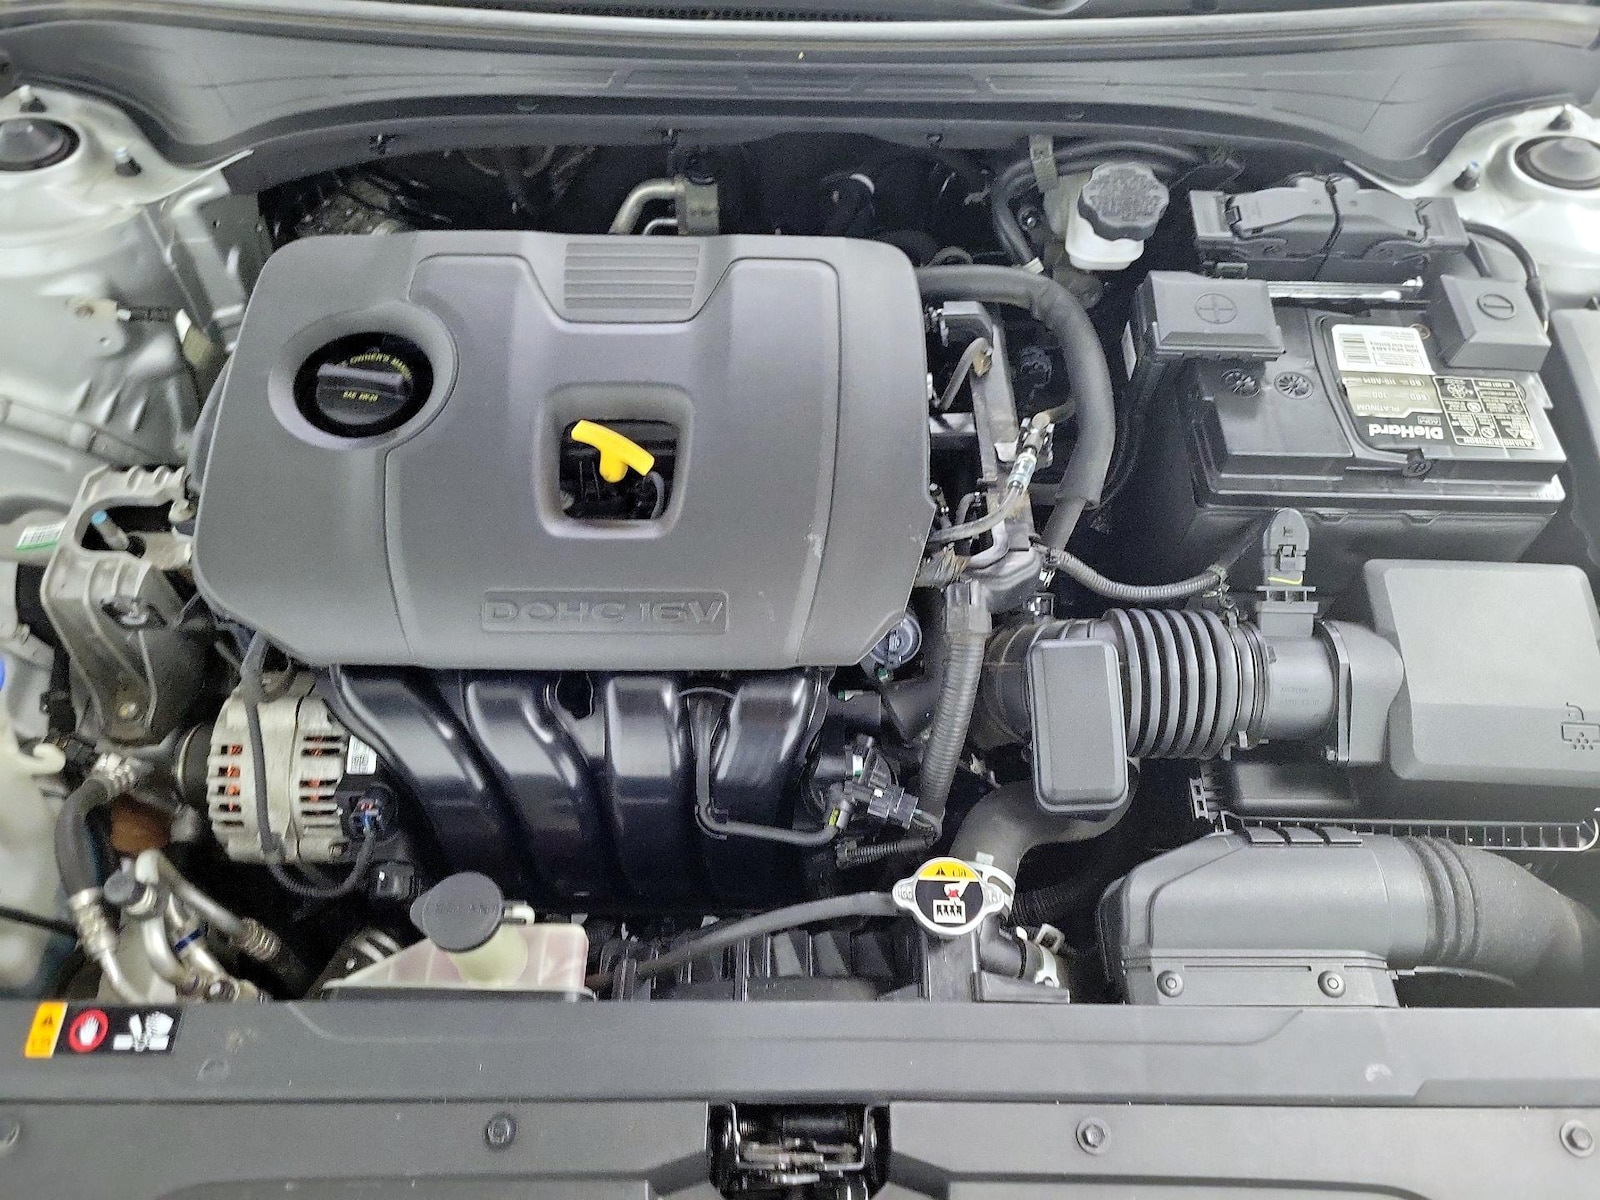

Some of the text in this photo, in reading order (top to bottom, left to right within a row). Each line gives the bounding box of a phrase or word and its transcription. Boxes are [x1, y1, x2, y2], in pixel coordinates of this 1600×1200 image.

[1356, 403, 1400, 412] PLATINUM
[1368, 423, 1444, 440] DieHard
[484, 598, 724, 625] DOHC 16V
